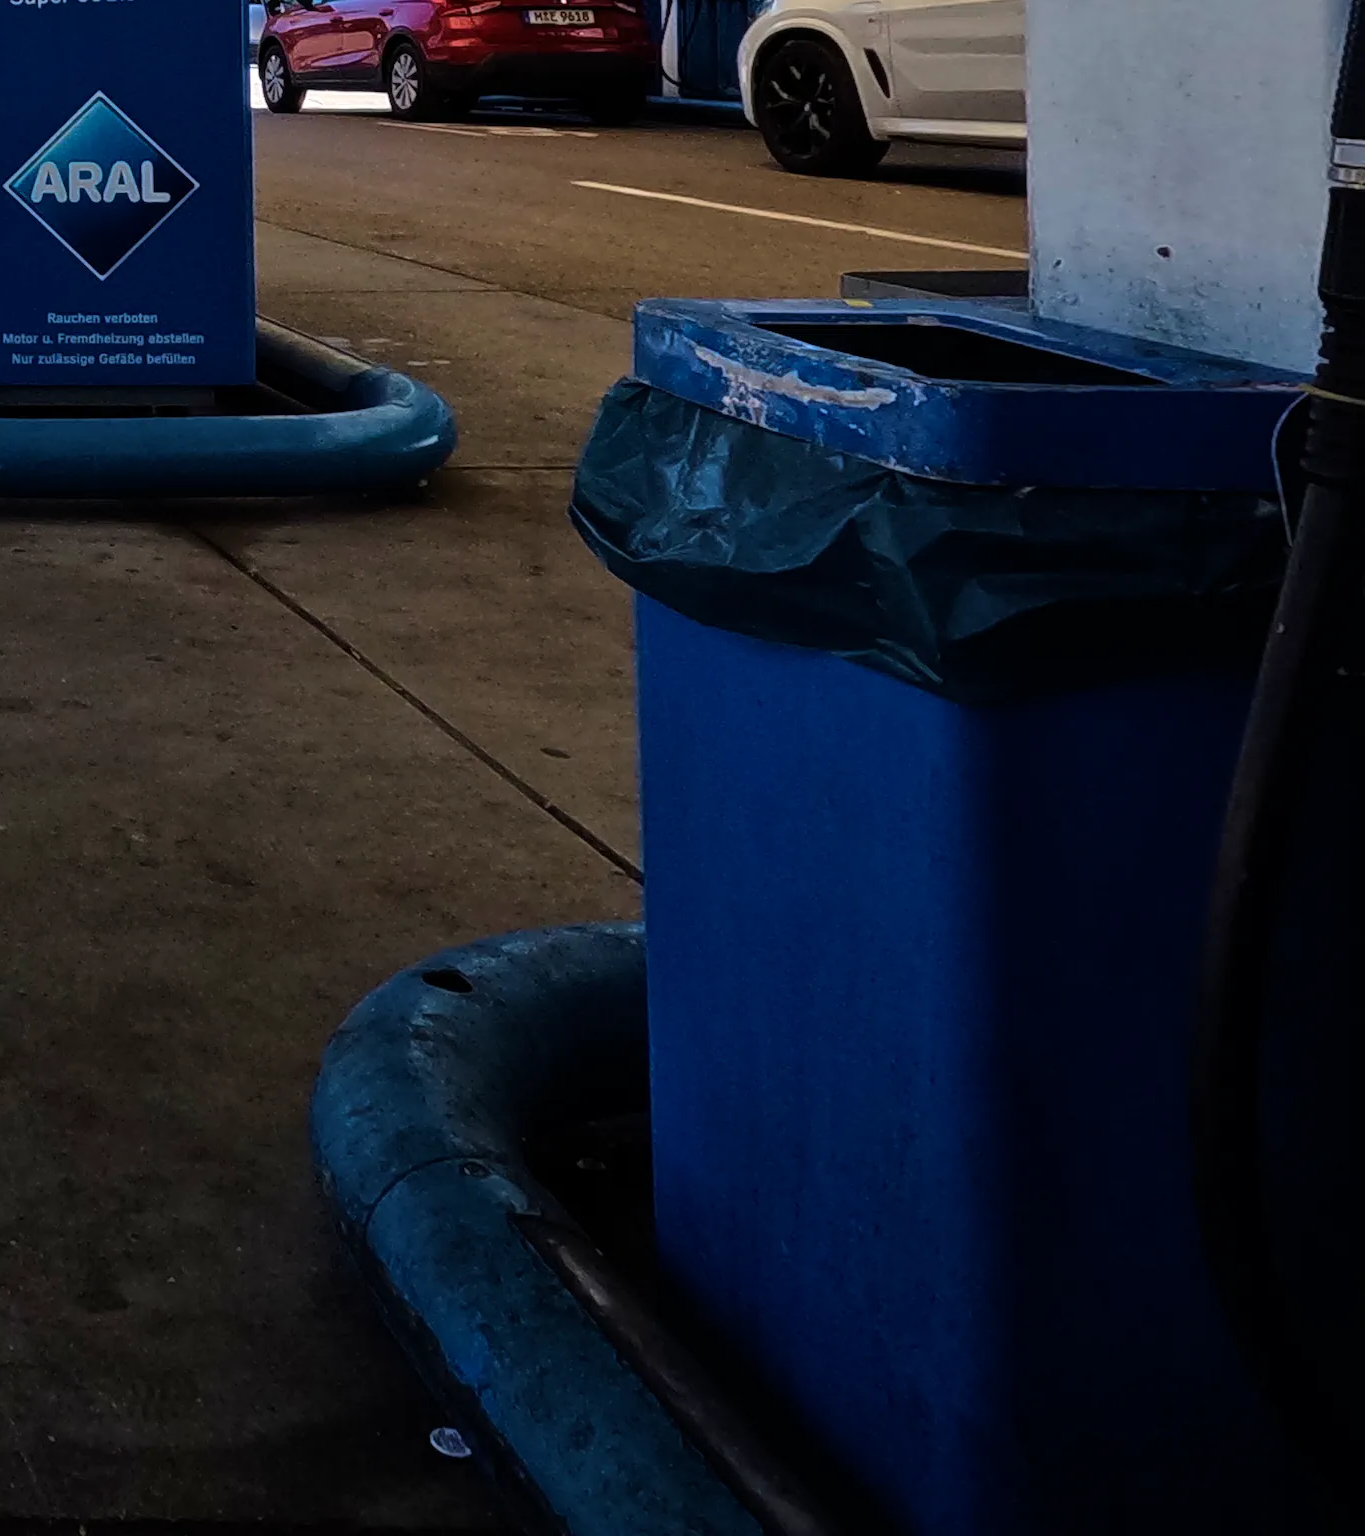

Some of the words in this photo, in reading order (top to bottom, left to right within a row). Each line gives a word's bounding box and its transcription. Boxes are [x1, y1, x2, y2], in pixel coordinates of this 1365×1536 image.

[30, 160, 171, 203] ARAL
[47, 312, 100, 323] Rauchen
[104, 312, 158, 323] verboten
[2, 333, 38, 344] Motor
[42, 334, 54, 344] u.
[57, 332, 144, 346] Fremdheizung
[148, 332, 205, 344] abstellen
[12, 353, 34, 364] Nur
[38, 352, 95, 366] zulässige
[99, 352, 143, 365] Gefäße
[146, 352, 196, 365] befüllen
